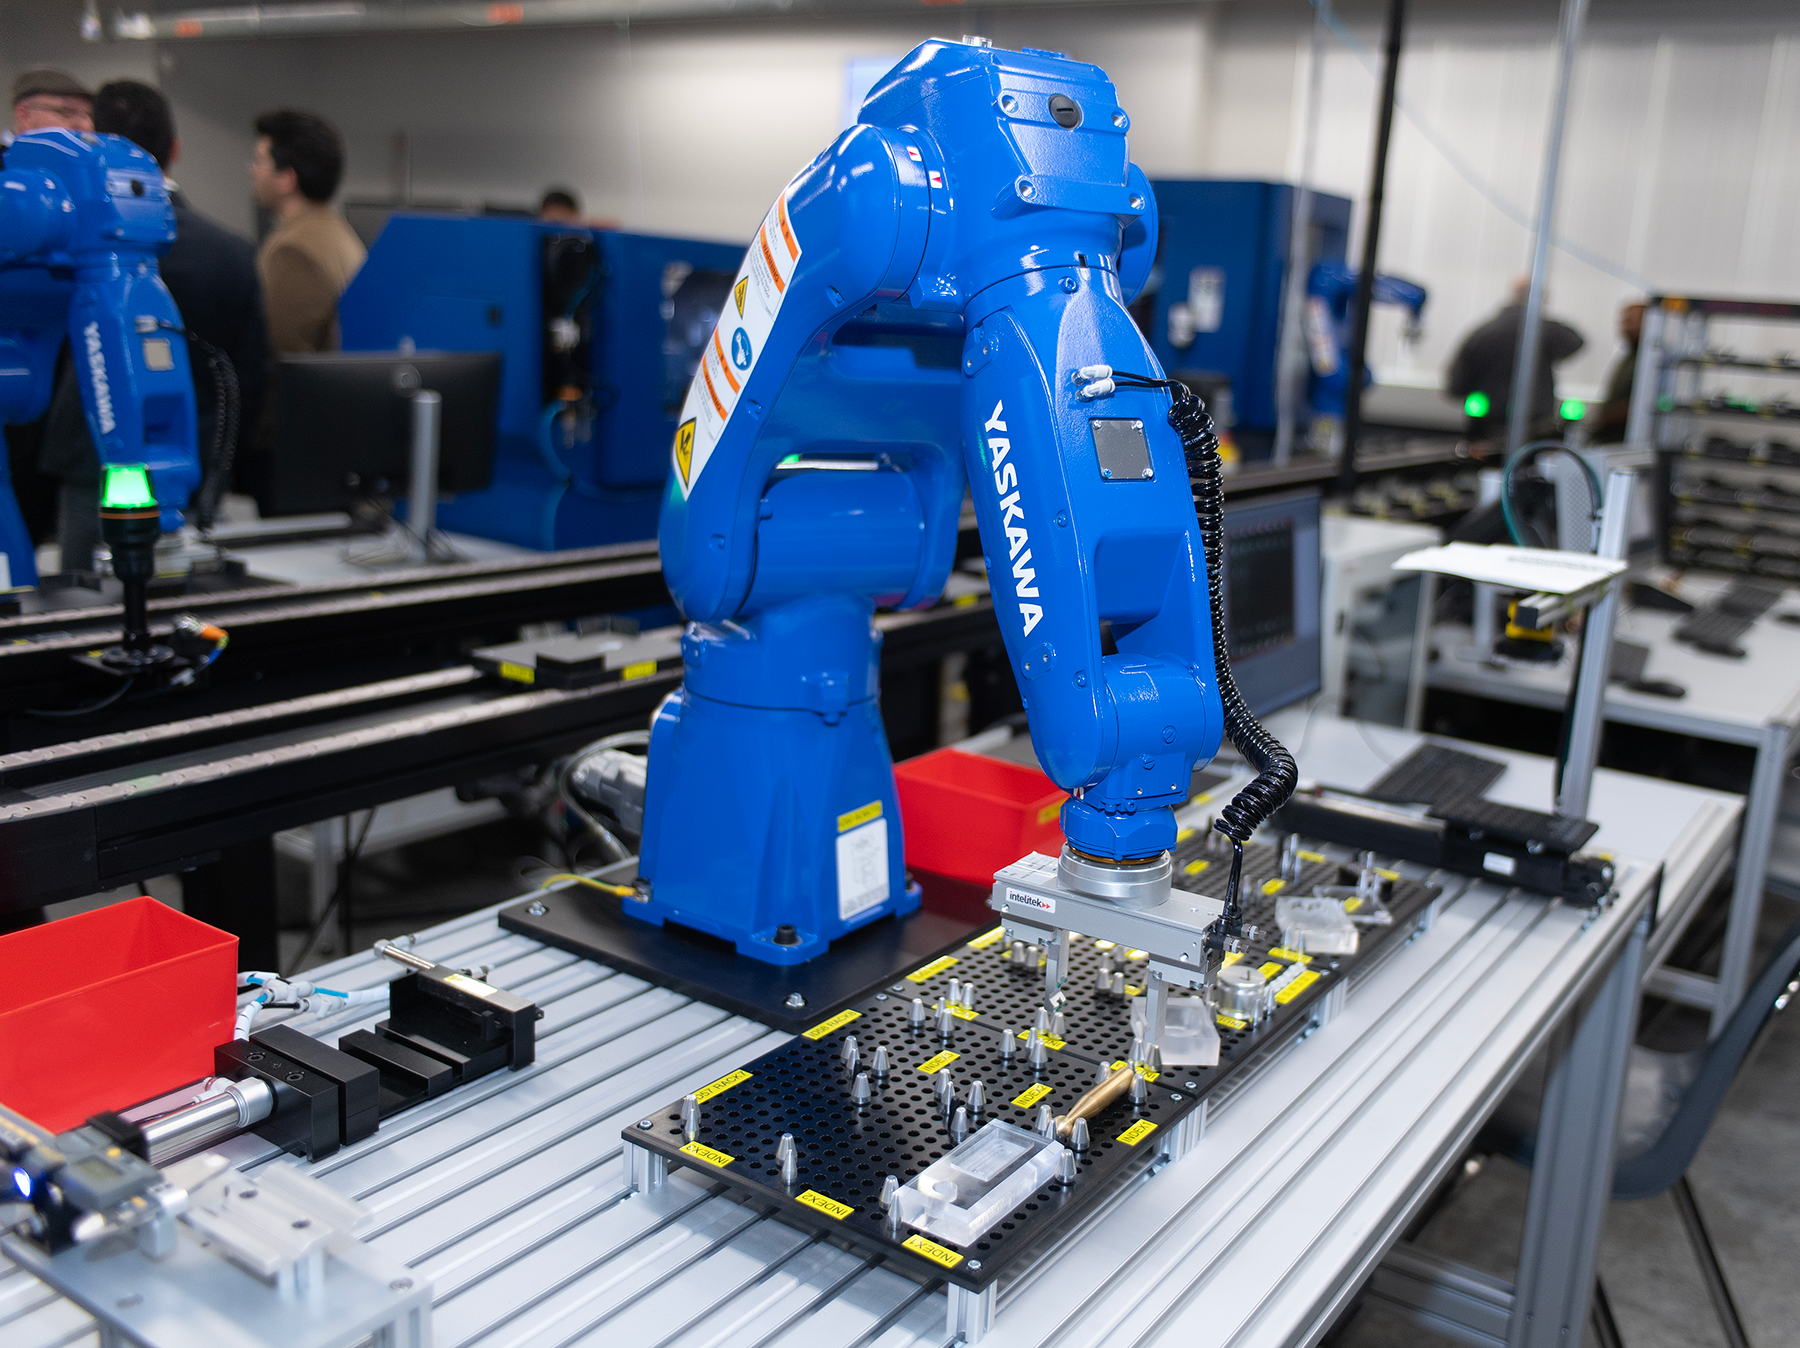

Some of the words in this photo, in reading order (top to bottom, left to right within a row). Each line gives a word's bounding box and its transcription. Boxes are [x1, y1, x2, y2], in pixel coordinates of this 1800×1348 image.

[763, 241, 780, 283] WARNING
[84, 320, 116, 434] YASKAWA
[985, 399, 1045, 637] YASKAWA
[1009, 890, 1042, 908] intelitek
[712, 1070, 747, 1089] RACK7
[1015, 1083, 1047, 1106] INDEX2
[1121, 1120, 1152, 1144] INDEX1
[684, 1143, 729, 1165] INDEX3
[800, 1192, 848, 1216] INDEX2
[908, 1237, 956, 1263] INDEX1
